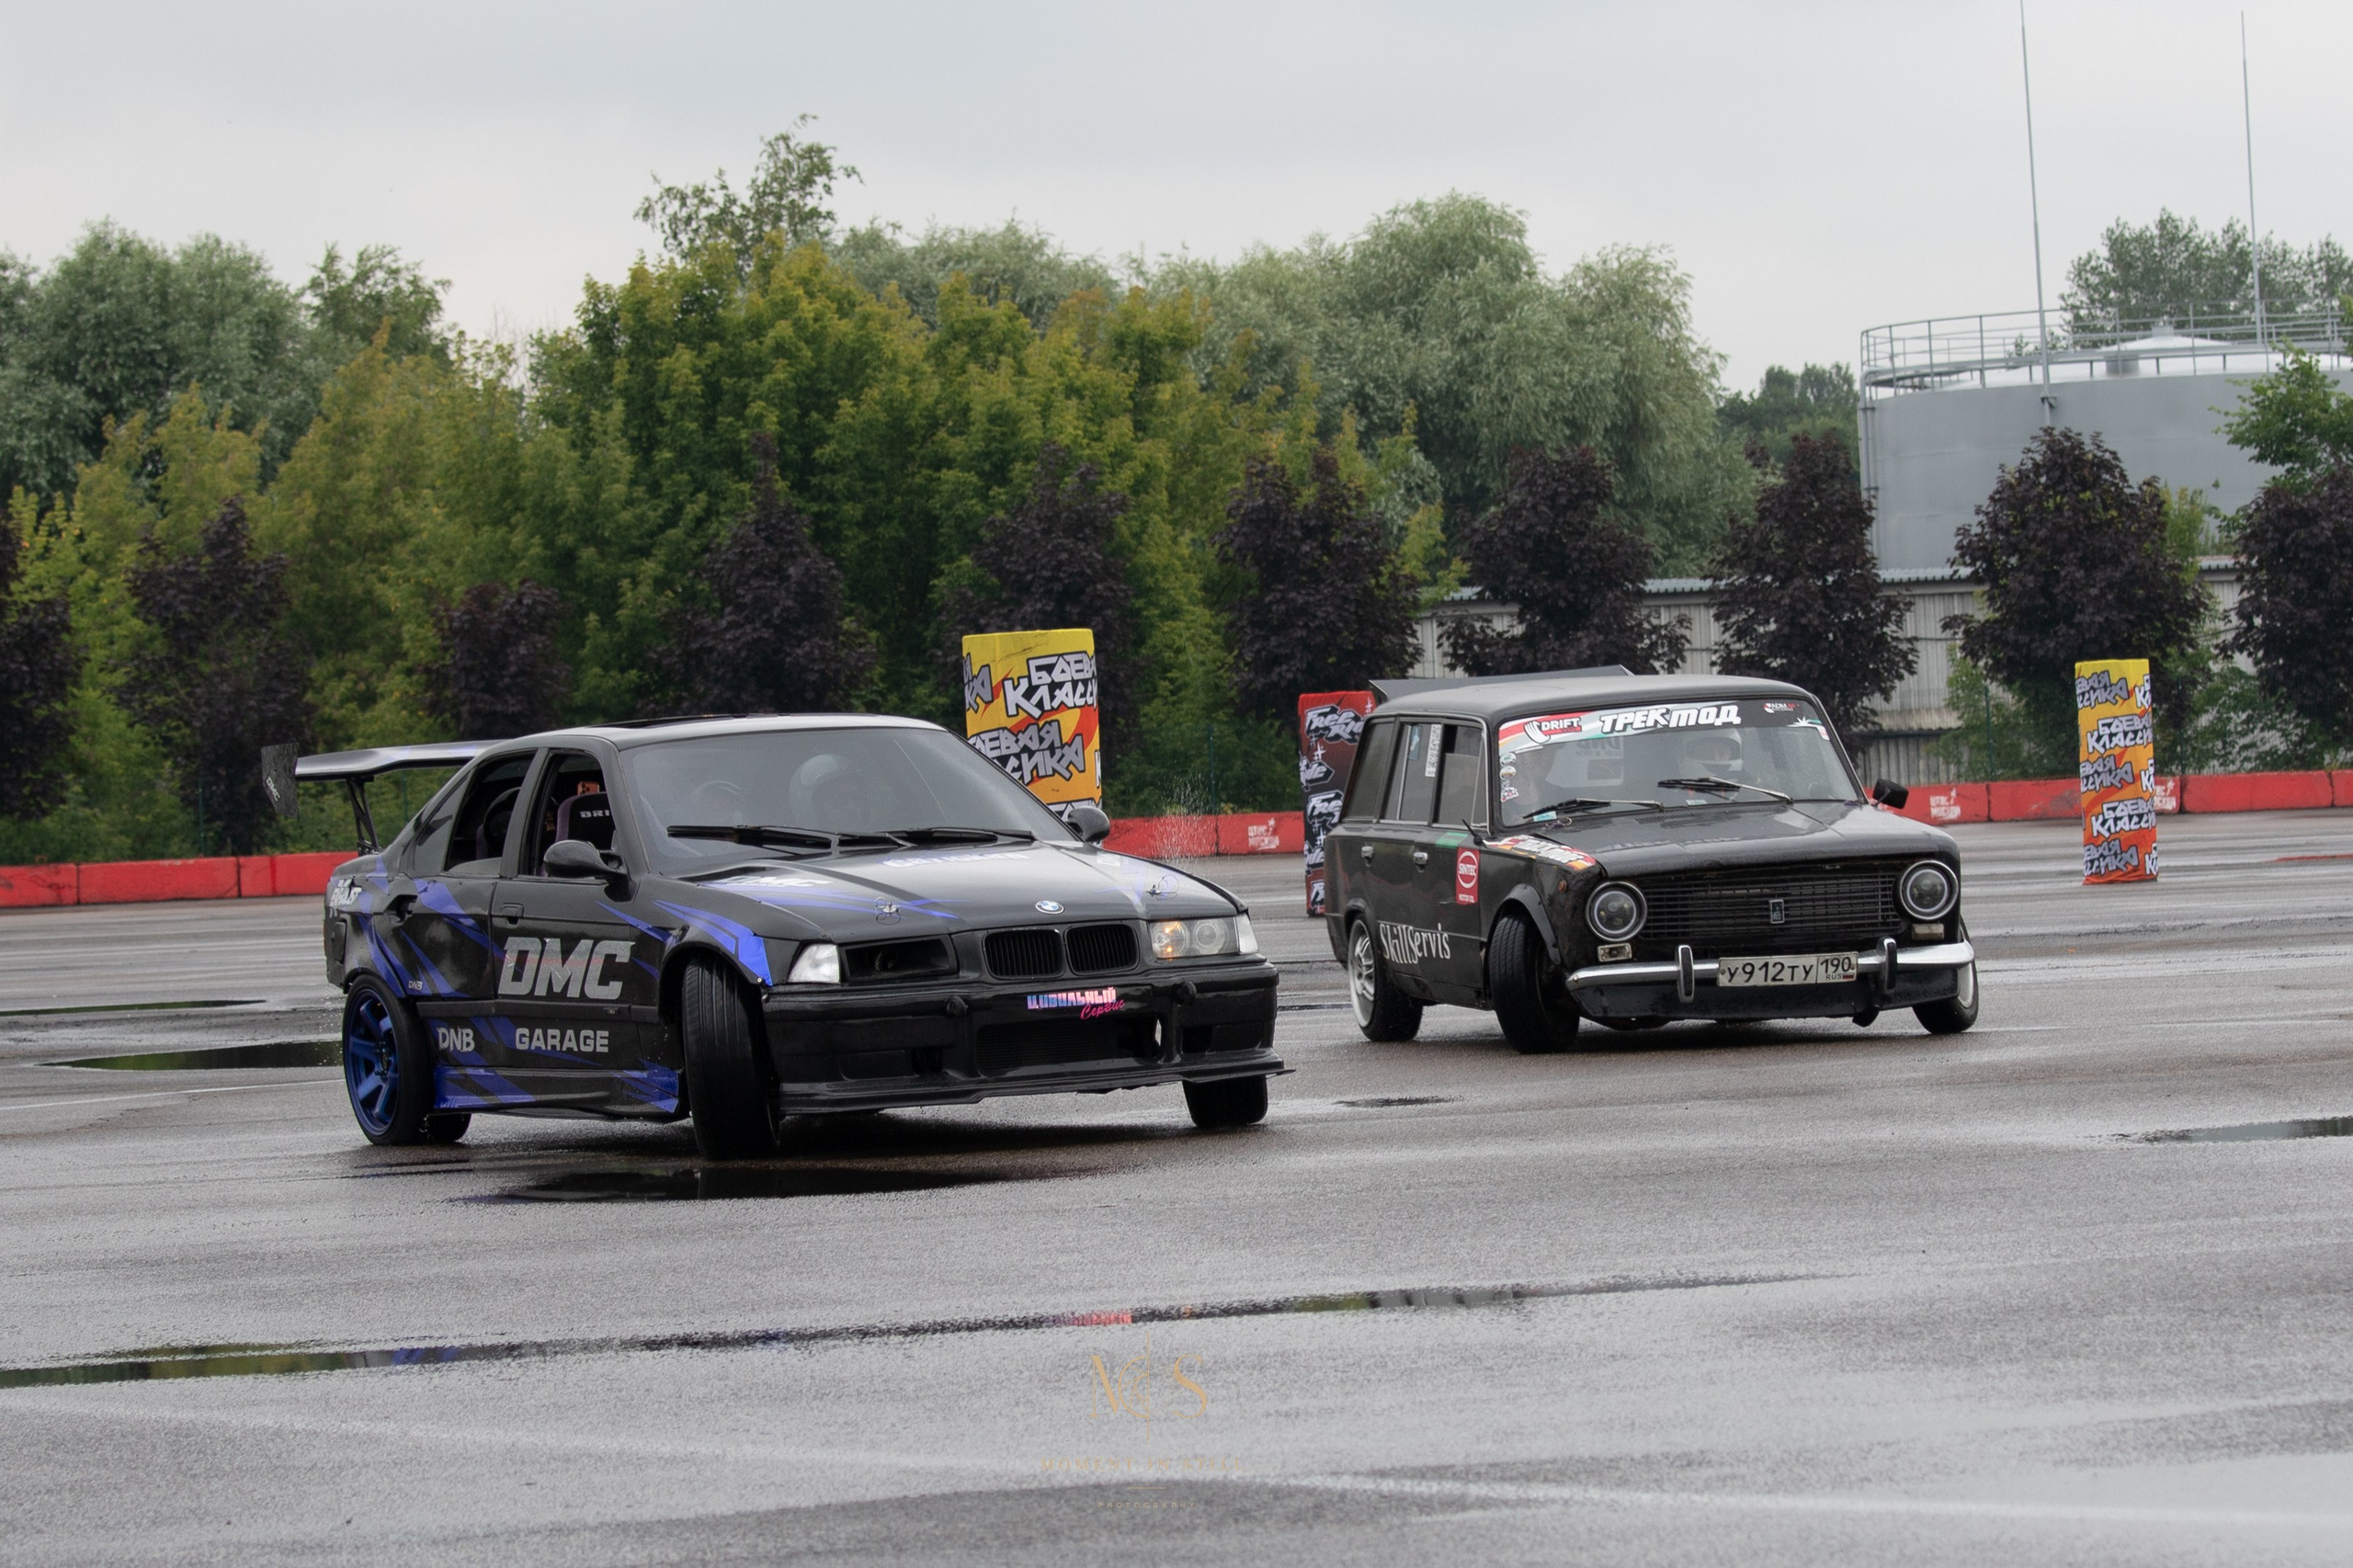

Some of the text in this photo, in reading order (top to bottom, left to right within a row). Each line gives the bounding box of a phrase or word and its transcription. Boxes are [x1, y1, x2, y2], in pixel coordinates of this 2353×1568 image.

[1028, 652, 1097, 686] БОЕВ
[1541, 718, 1580, 731] DRIFT
[1459, 863, 1476, 876] SINTEC
[498, 937, 636, 1000] DMC
[1820, 957, 1852, 974] 190
[408, 981, 423, 990] DNB
[436, 1026, 608, 1053] DNB GARAGE
